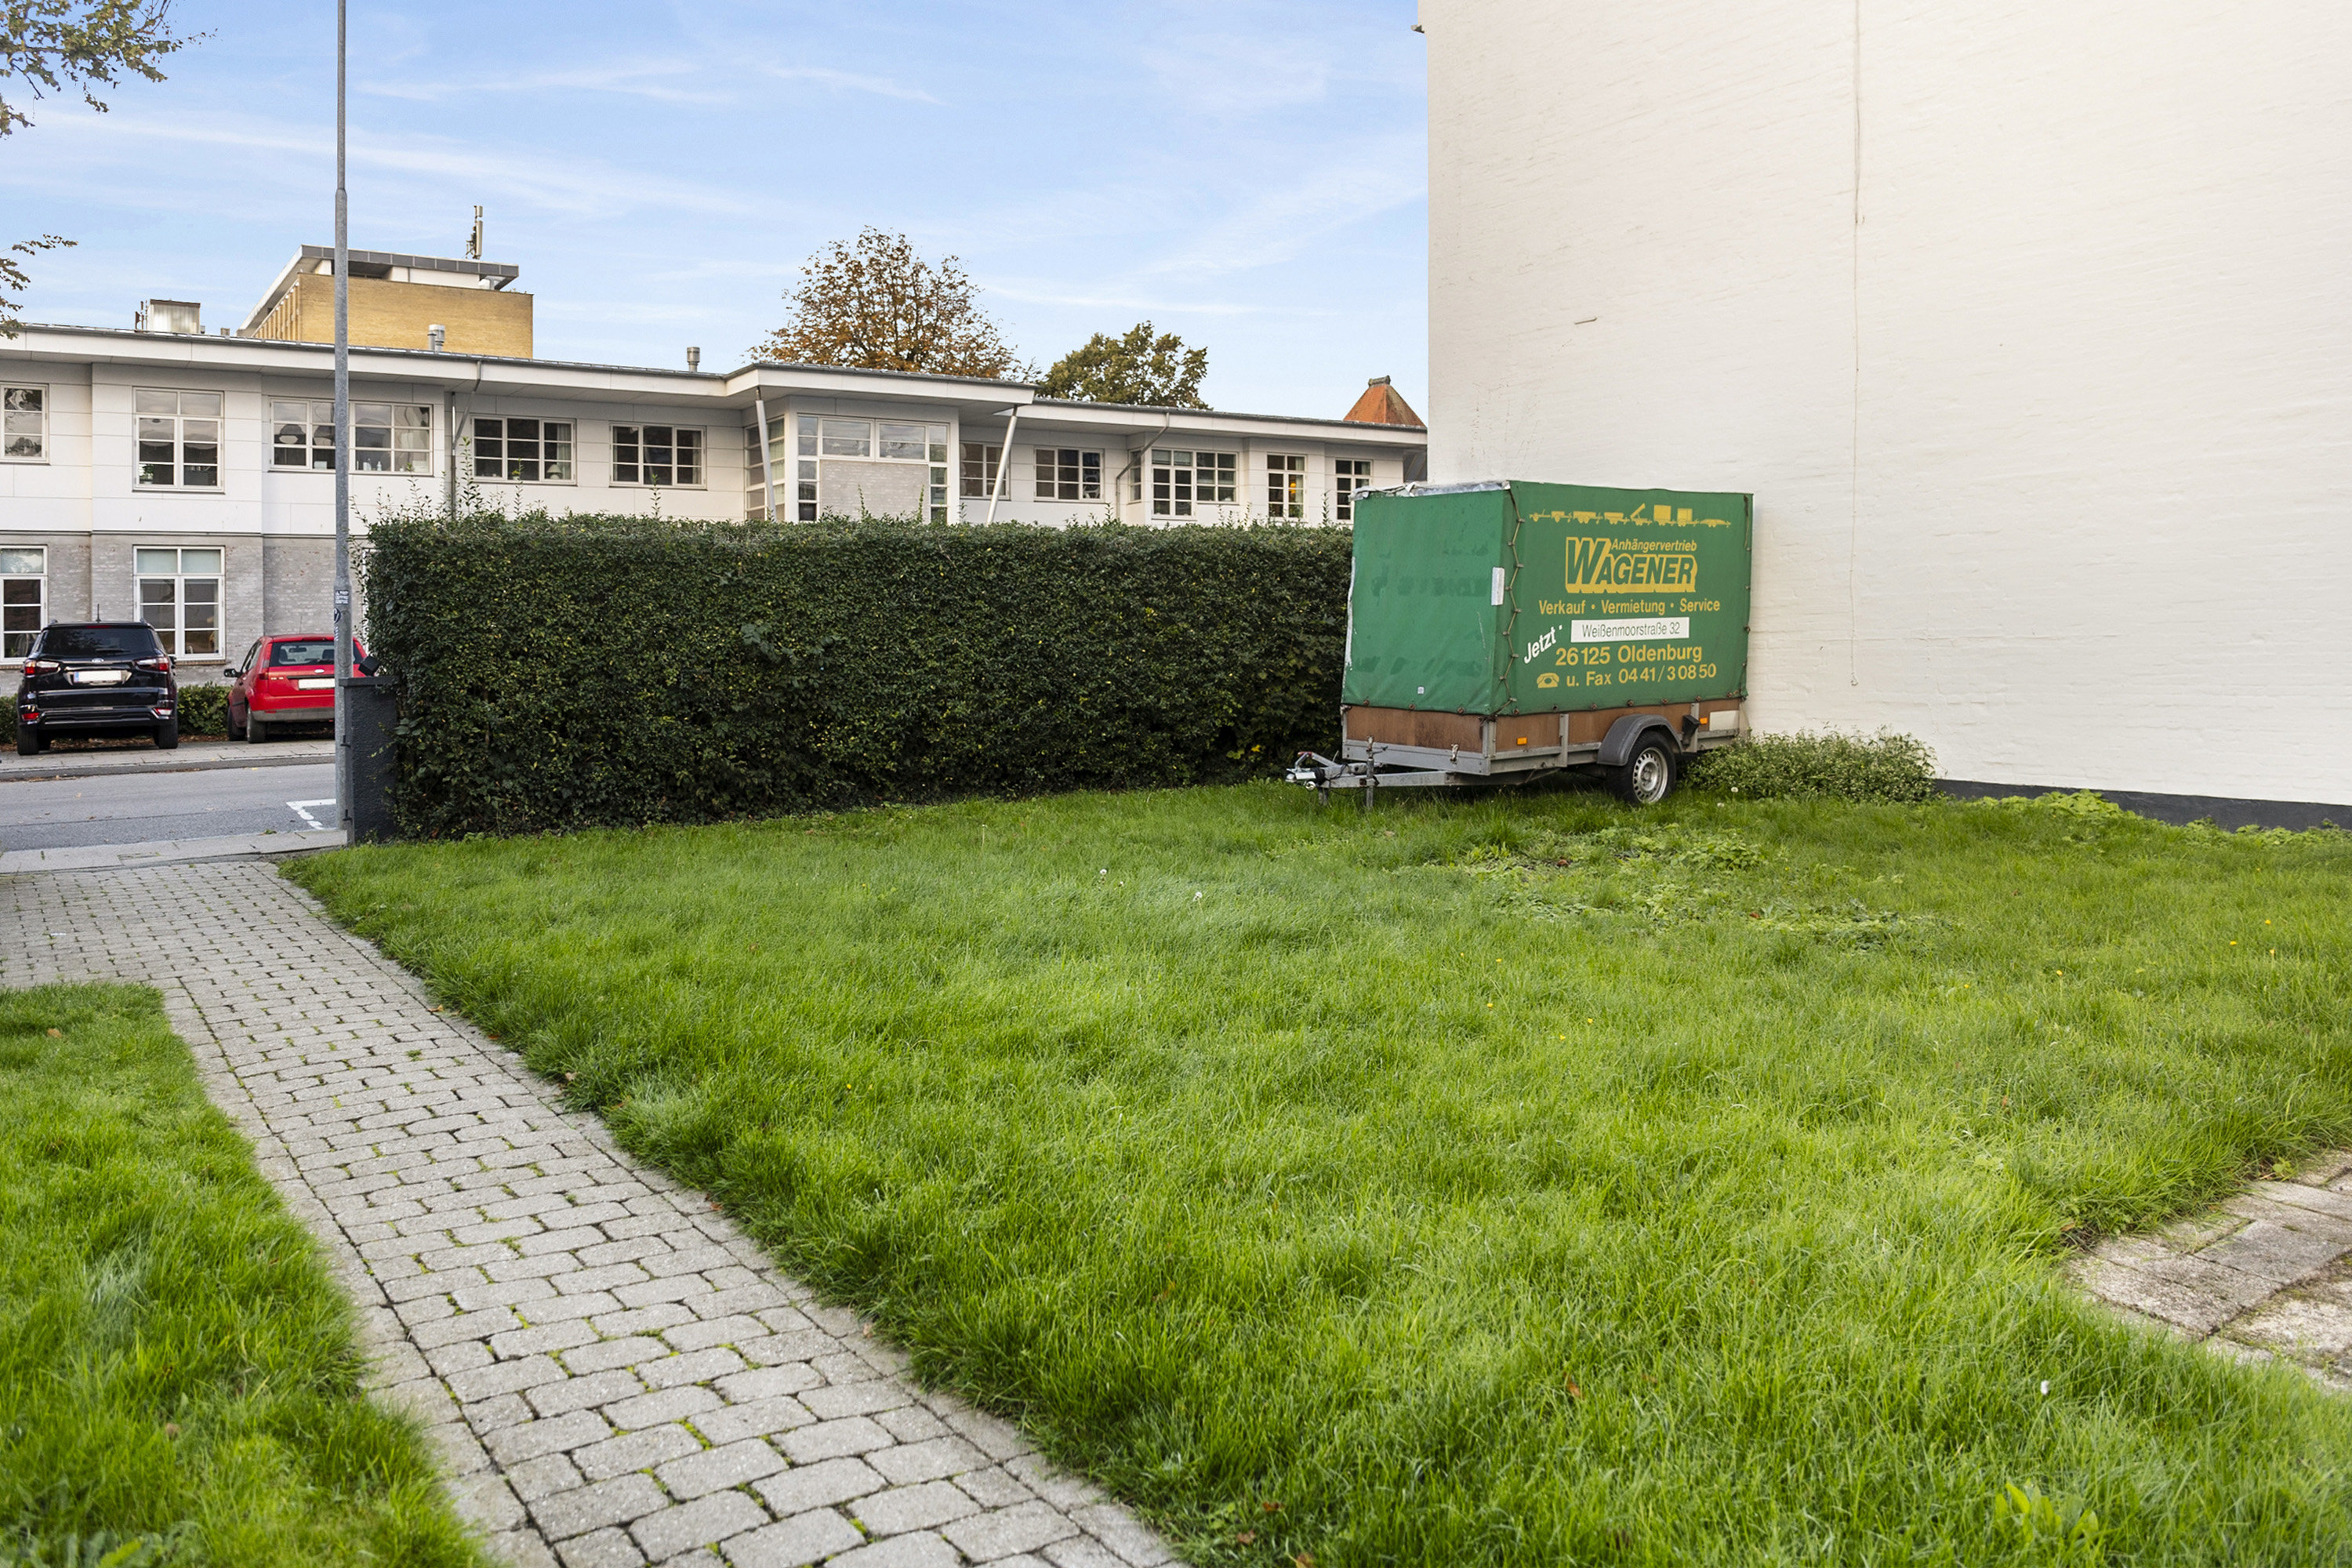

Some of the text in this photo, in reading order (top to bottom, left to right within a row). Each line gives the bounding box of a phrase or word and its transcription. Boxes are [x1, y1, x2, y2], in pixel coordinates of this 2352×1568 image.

[1610, 538, 1697, 553] Anhängervertrieb
[1565, 537, 1697, 593] WAGENER
[1538, 597, 1720, 615] Verkauf Vermietung Service
[1581, 622, 1680, 637] Weißenmoorstraße 32
[1617, 644, 1702, 662] Oldenburg
[1566, 676, 1579, 687] u.
[1586, 671, 1612, 686] Fax
